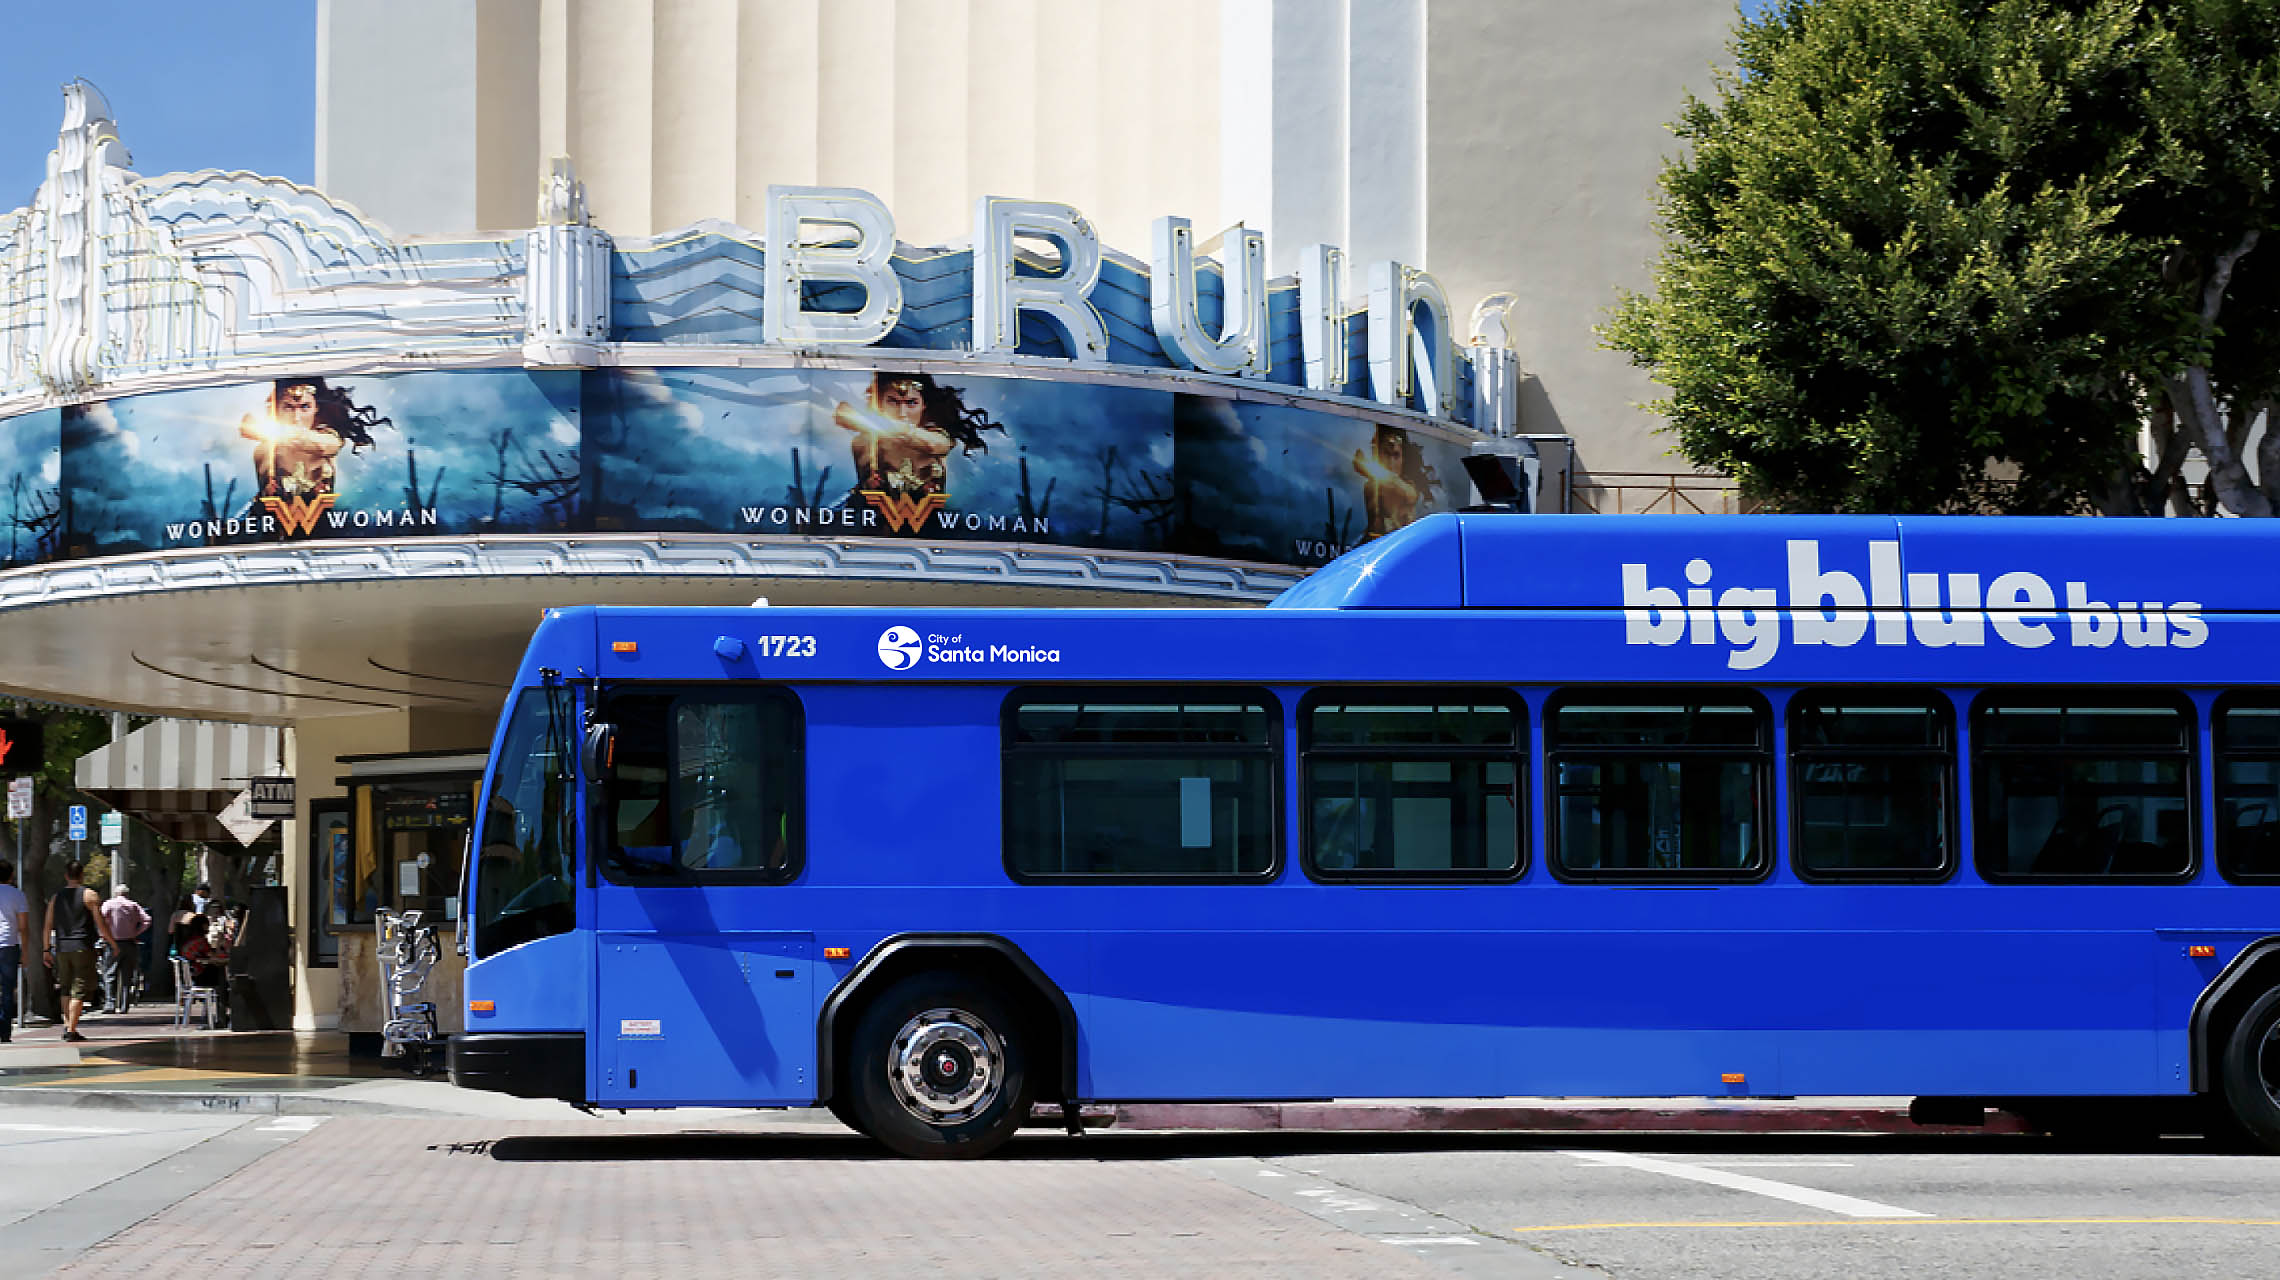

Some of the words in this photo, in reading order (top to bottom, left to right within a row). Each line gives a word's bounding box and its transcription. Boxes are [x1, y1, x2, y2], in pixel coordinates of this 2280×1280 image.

[166, 515, 275, 540] WONDER
[327, 508, 437, 529] WOMAN
[741, 507, 877, 527] WONDER
[937, 511, 1049, 535] WOMAN
[1621, 558, 1780, 670] big
[1786, 540, 2056, 647] blue
[2066, 581, 2209, 648] bus
[757, 635, 817, 657] 1723
[928, 634, 949, 645] City
[951, 633, 962, 644] of
[928, 646, 985, 663] Santa
[989, 645, 1060, 663] Monica
[253, 783, 294, 801] ATM
